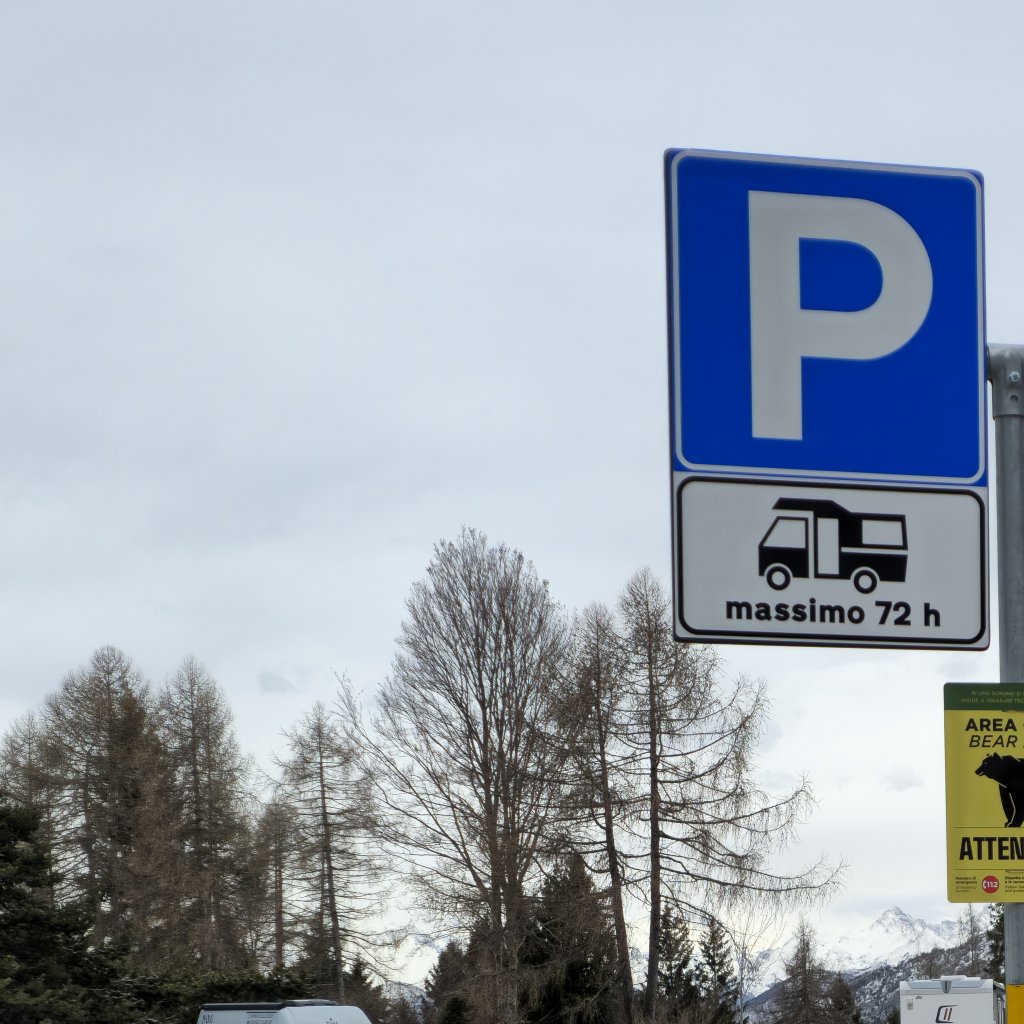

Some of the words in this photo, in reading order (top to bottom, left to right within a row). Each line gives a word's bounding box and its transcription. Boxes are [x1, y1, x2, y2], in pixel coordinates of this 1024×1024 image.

[748, 190, 933, 440] P
[726, 598, 865, 625] massimo
[876, 601, 911, 625] 72
[924, 603, 940, 627] h
[965, 719, 1017, 731] AREA
[969, 735, 1017, 747] BEAR
